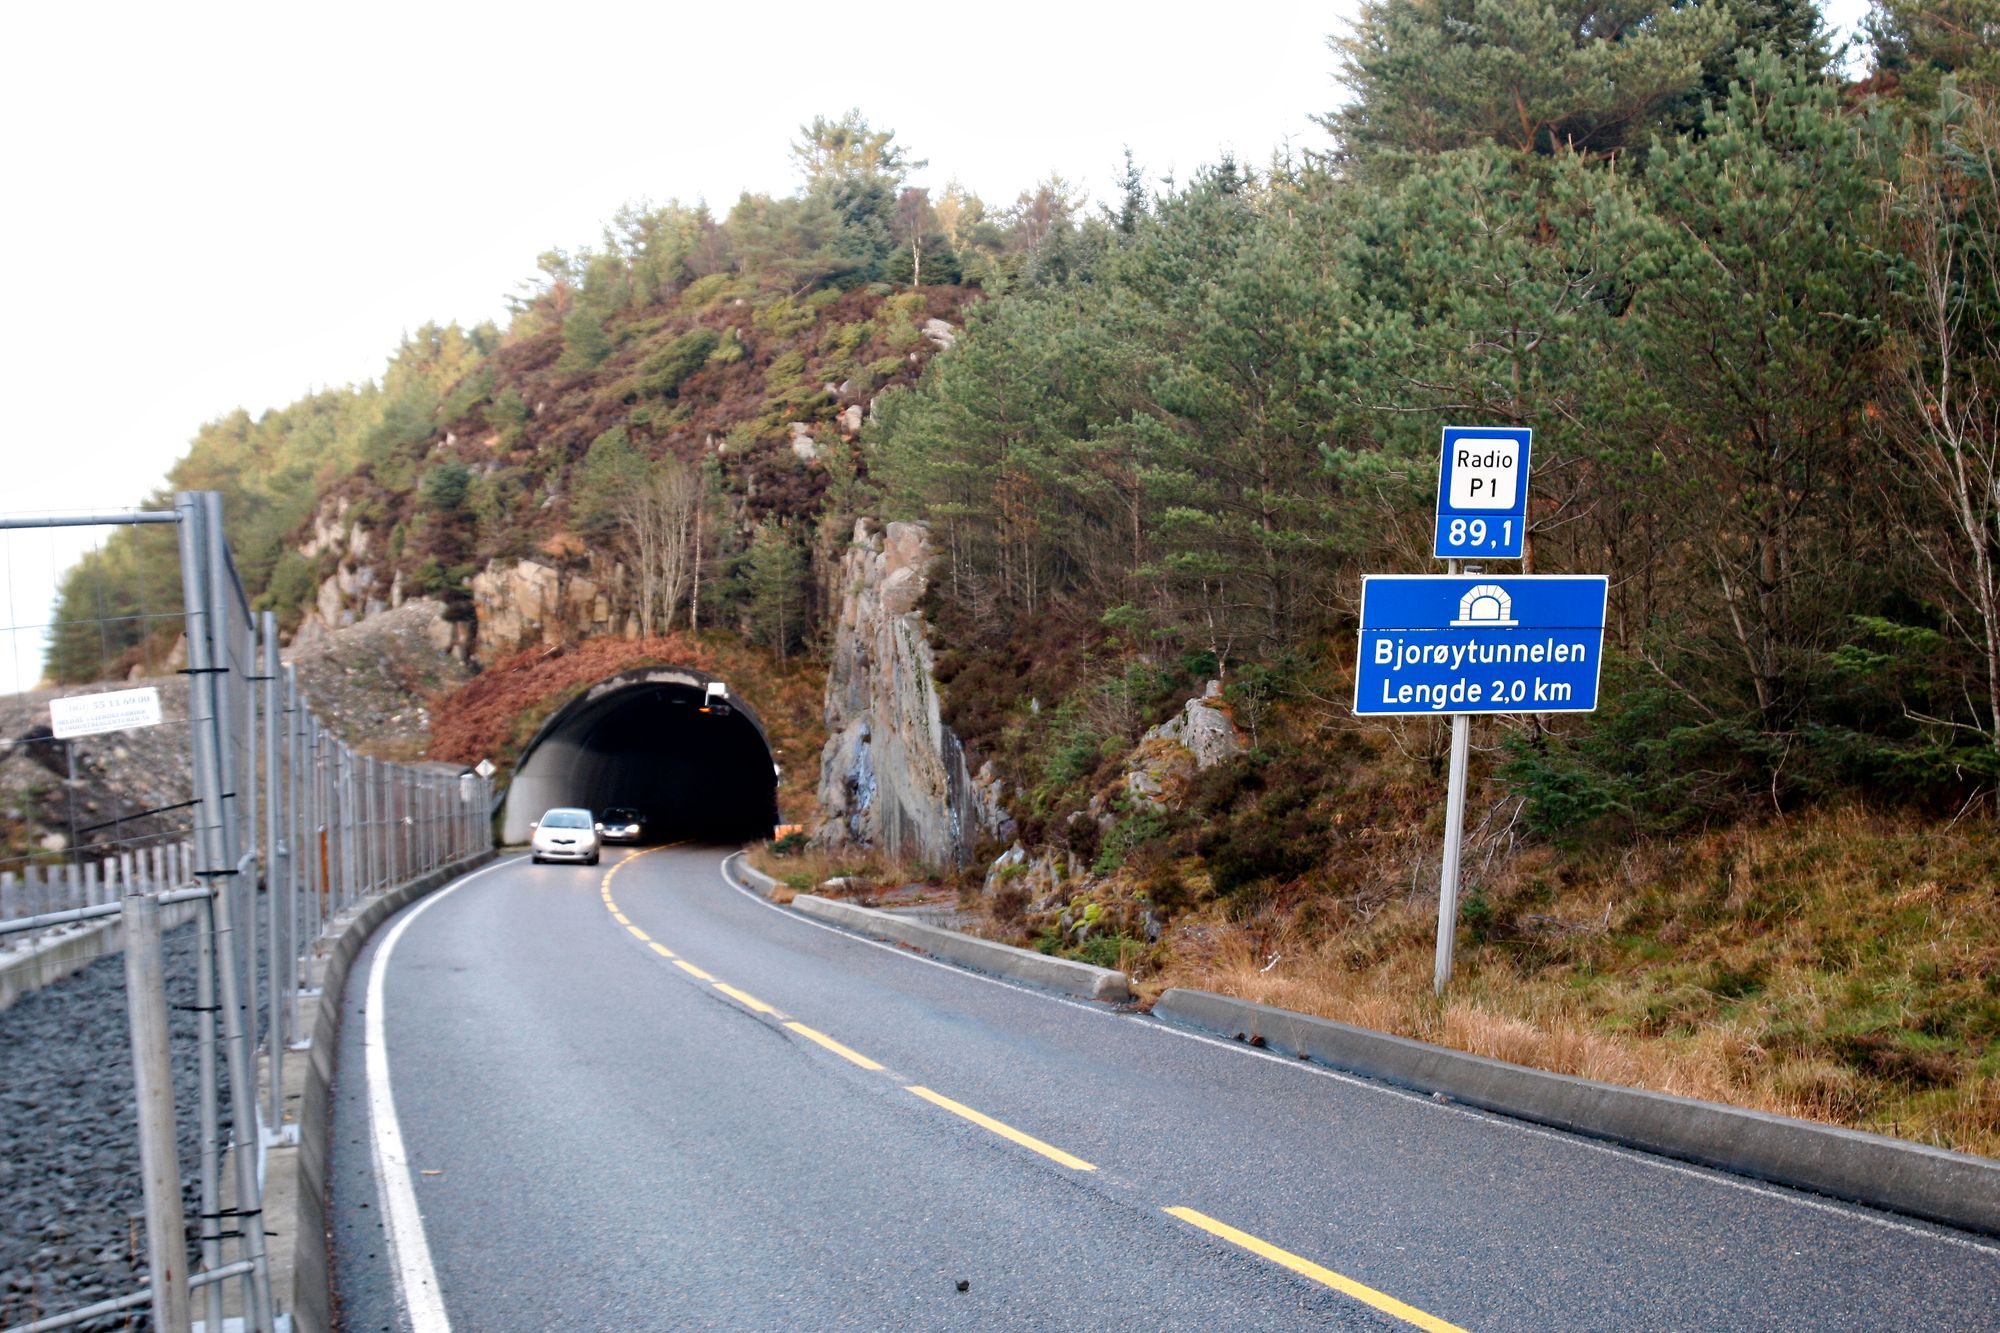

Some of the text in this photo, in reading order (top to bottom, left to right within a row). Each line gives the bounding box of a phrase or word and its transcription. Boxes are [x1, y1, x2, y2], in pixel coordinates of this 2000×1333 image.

[1457, 450, 1513, 468] Radio
[1449, 518, 1512, 549] 89,1
[1374, 638, 1586, 671] Bjorøytunnelen
[1382, 676, 1572, 710] Lengde 2,0 km
